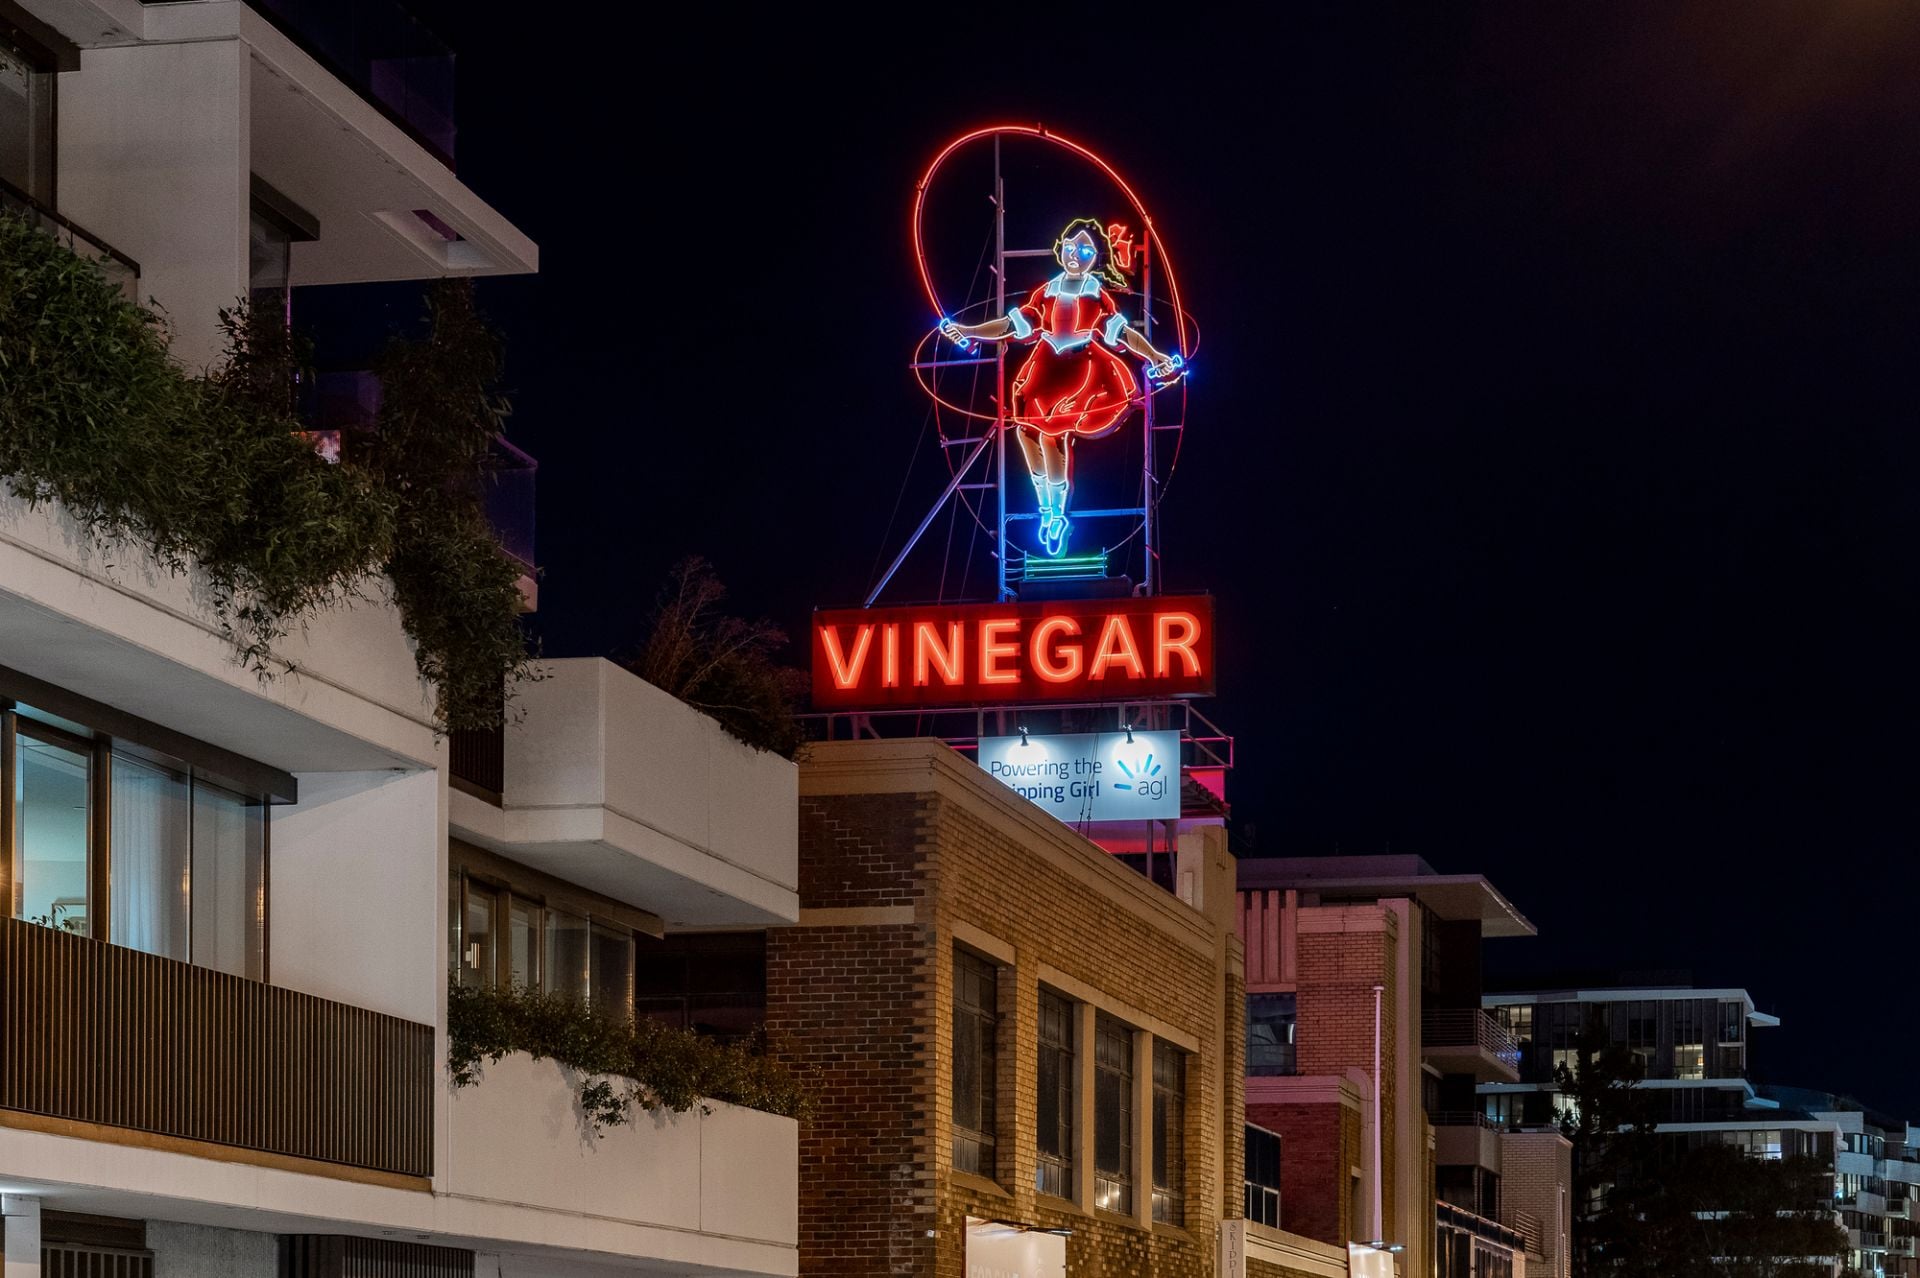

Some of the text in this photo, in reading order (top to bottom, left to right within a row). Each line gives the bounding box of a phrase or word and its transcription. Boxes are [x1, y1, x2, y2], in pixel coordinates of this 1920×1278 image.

[818, 612, 1201, 689] VINEGAR
[991, 757, 1102, 780] Powering the
[1070, 781, 1100, 798] Girl
[1138, 776, 1167, 800] agl
